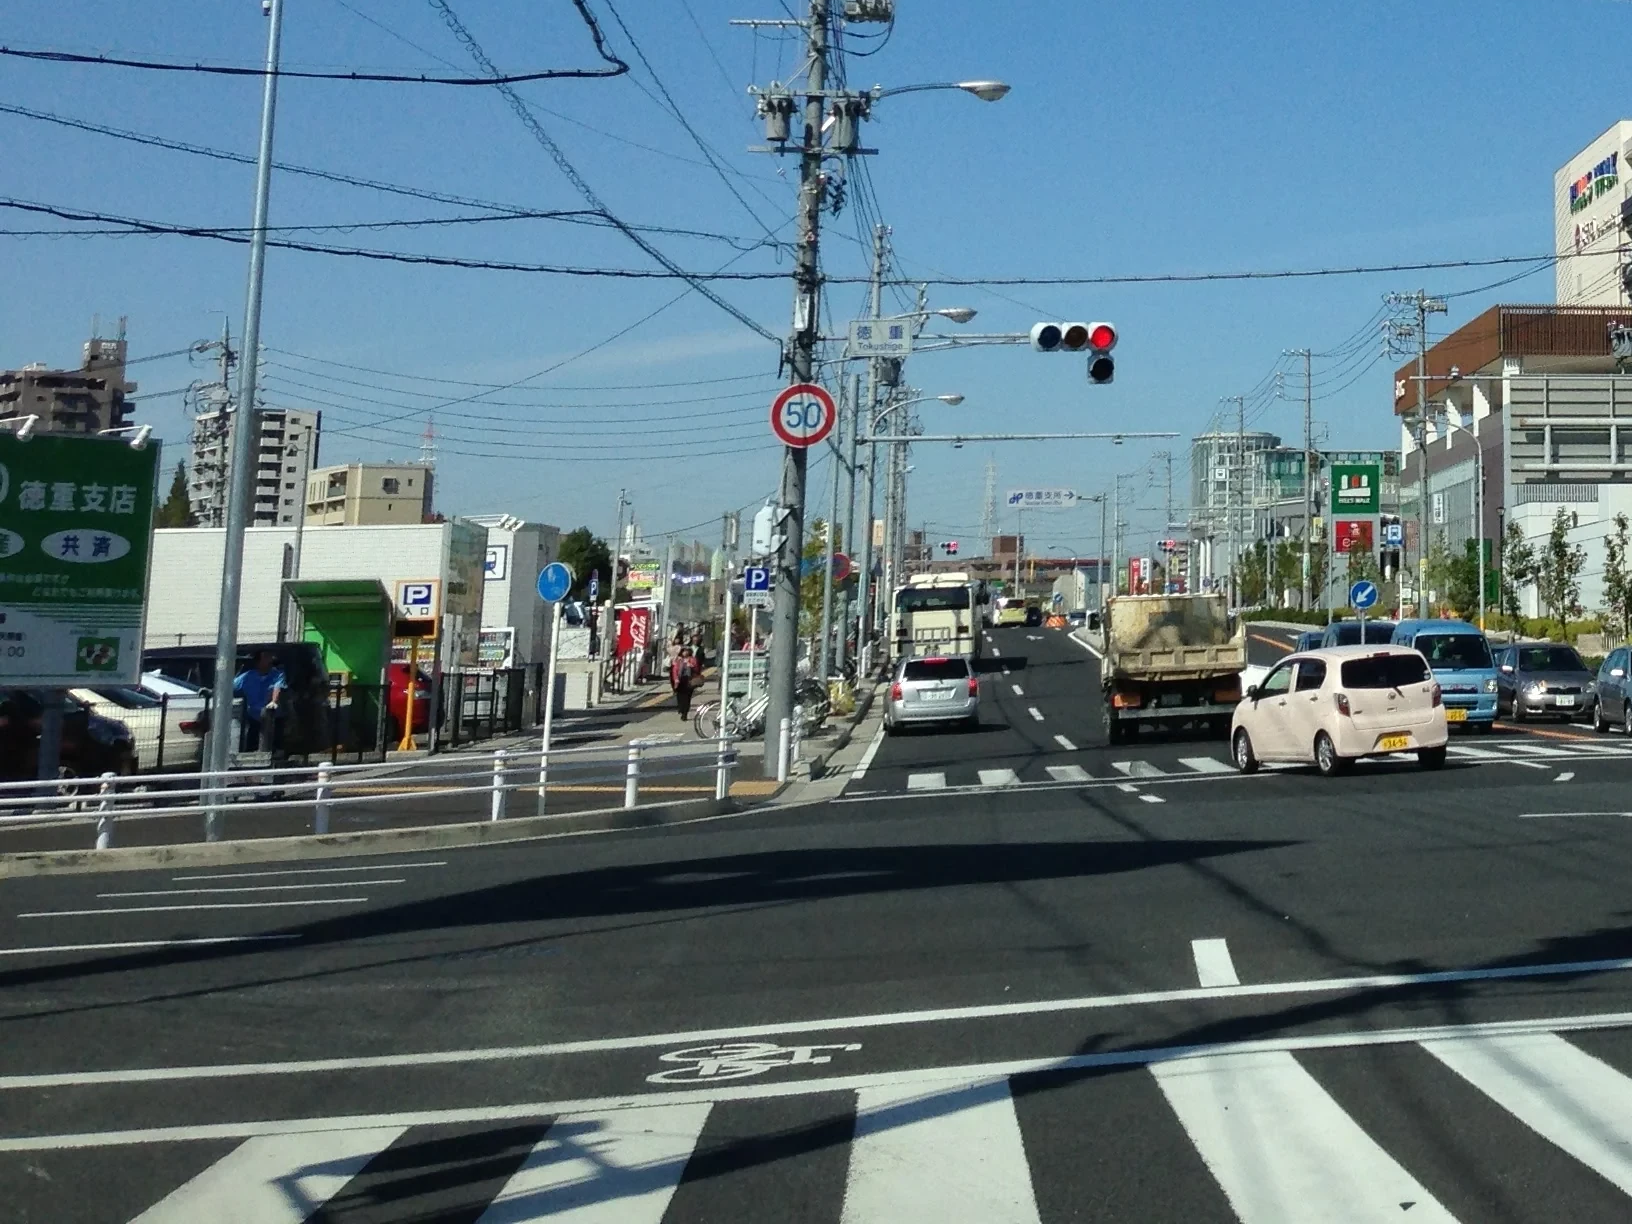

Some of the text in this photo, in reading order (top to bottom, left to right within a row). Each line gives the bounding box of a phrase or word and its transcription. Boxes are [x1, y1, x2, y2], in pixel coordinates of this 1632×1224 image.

[857, 342, 904, 351] Tokushige
[786, 402, 822, 428] 50
[18, 480, 137, 514] 徳重支店
[61, 534, 112, 557] 共済
[751, 569, 766, 589] P
[406, 586, 430, 604] P
[404, 607, 430, 616] 入口
